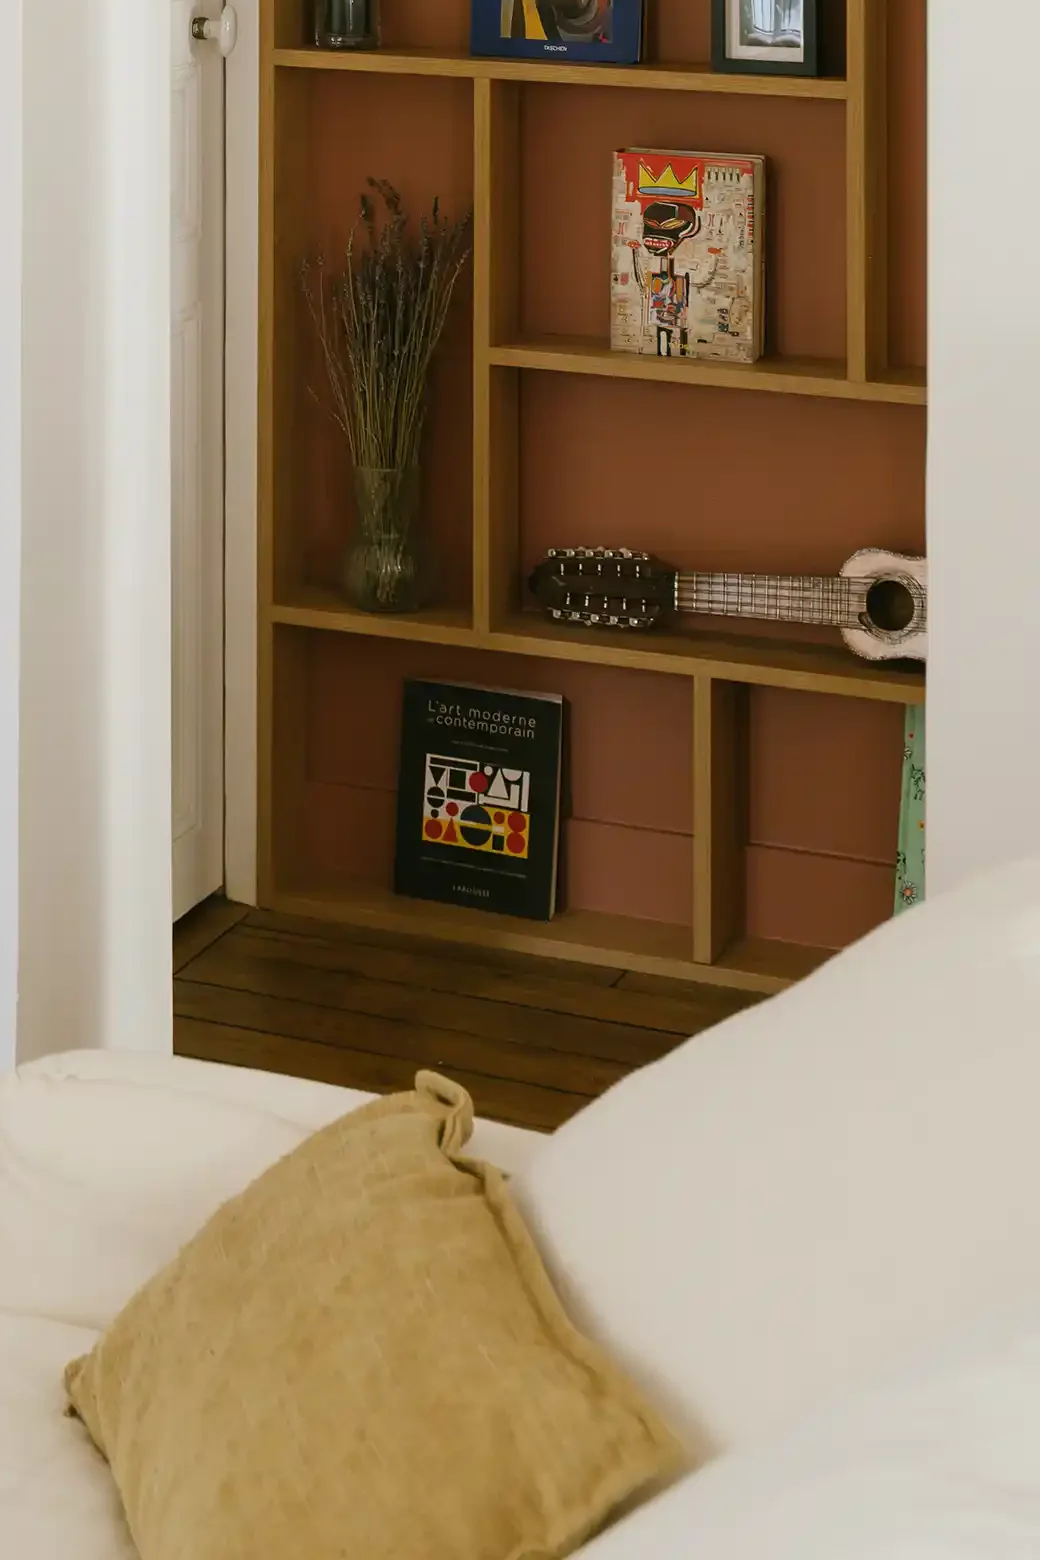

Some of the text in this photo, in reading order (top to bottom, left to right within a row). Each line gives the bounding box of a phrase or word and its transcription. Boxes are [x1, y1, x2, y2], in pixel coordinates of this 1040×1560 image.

[428, 699, 536, 728] L'art moderne
[435, 715, 535, 740] contemporain
